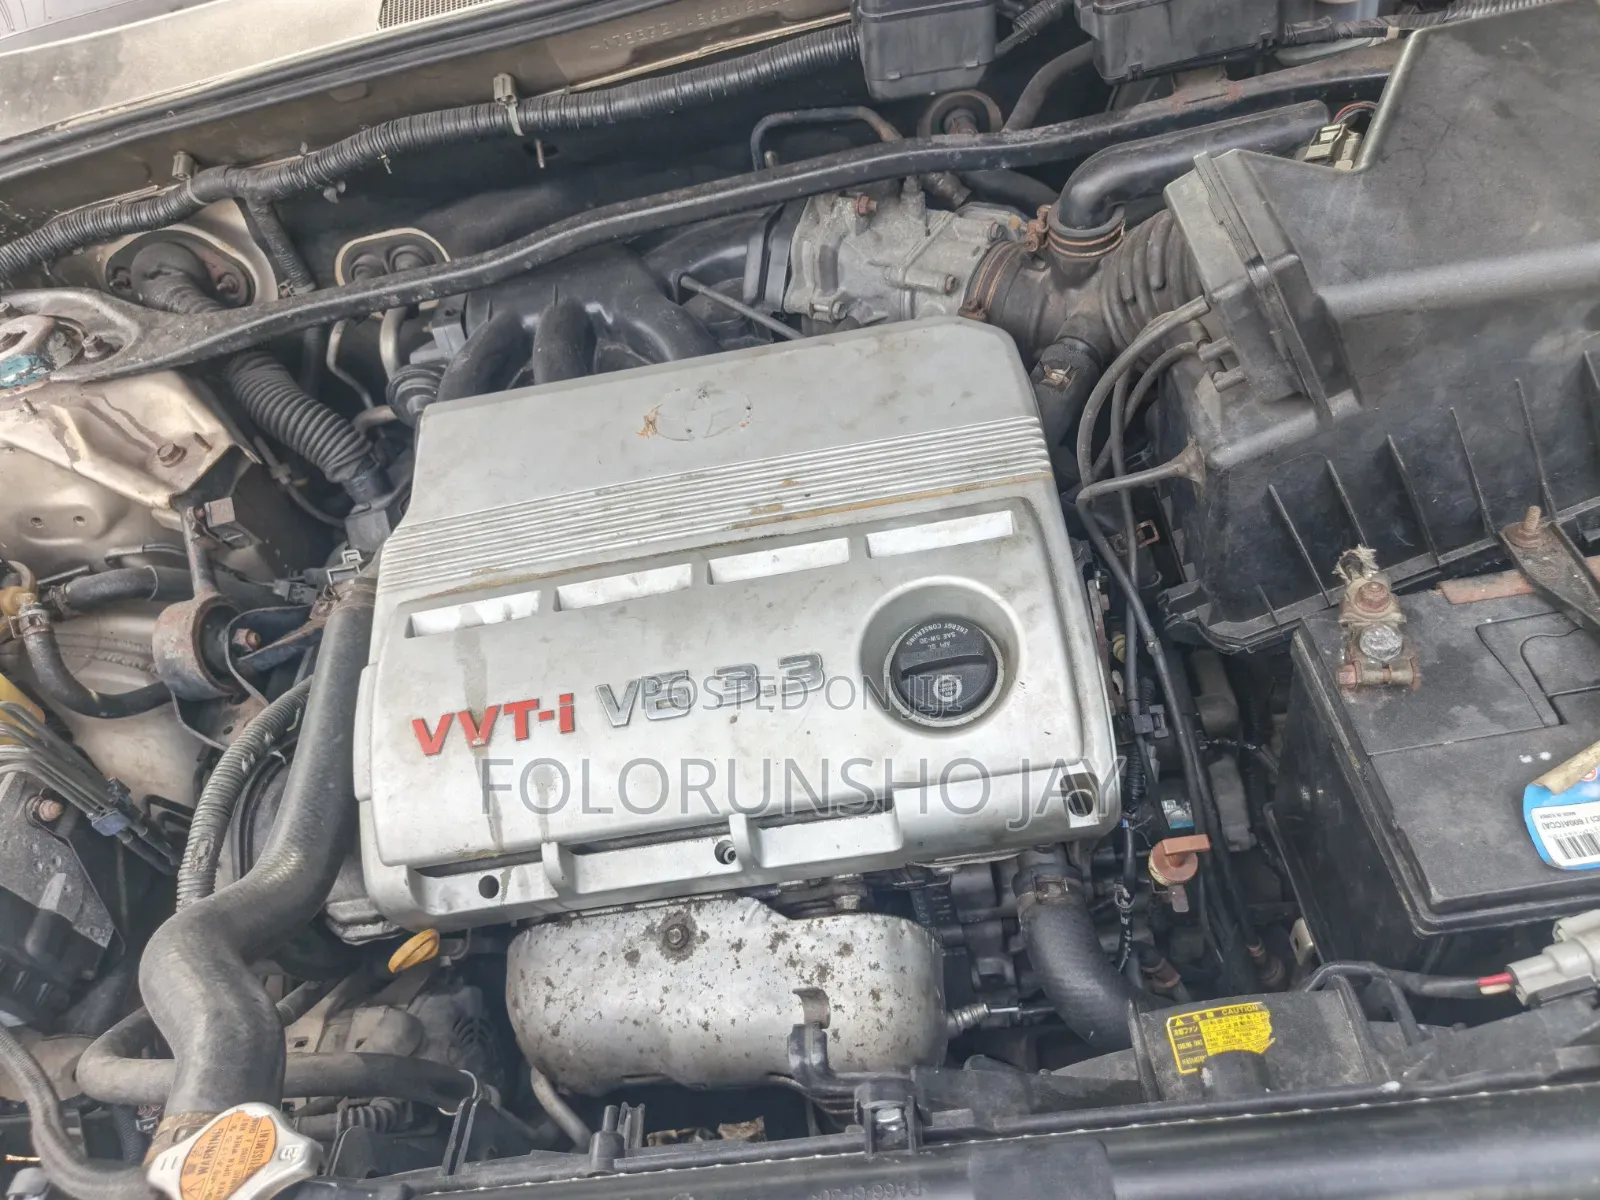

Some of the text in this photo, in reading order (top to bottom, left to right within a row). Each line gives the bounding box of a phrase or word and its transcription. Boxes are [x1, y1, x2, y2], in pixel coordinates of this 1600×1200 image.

[906, 622, 969, 647] ENERGY CONSERVING
[943, 632, 956, 640] SAE
[595, 652, 825, 728] V6 3.3
[411, 692, 575, 757] VVT-i
[1221, 1004, 1259, 1016] CAUTION
[197, 1128, 225, 1176] WARNING
